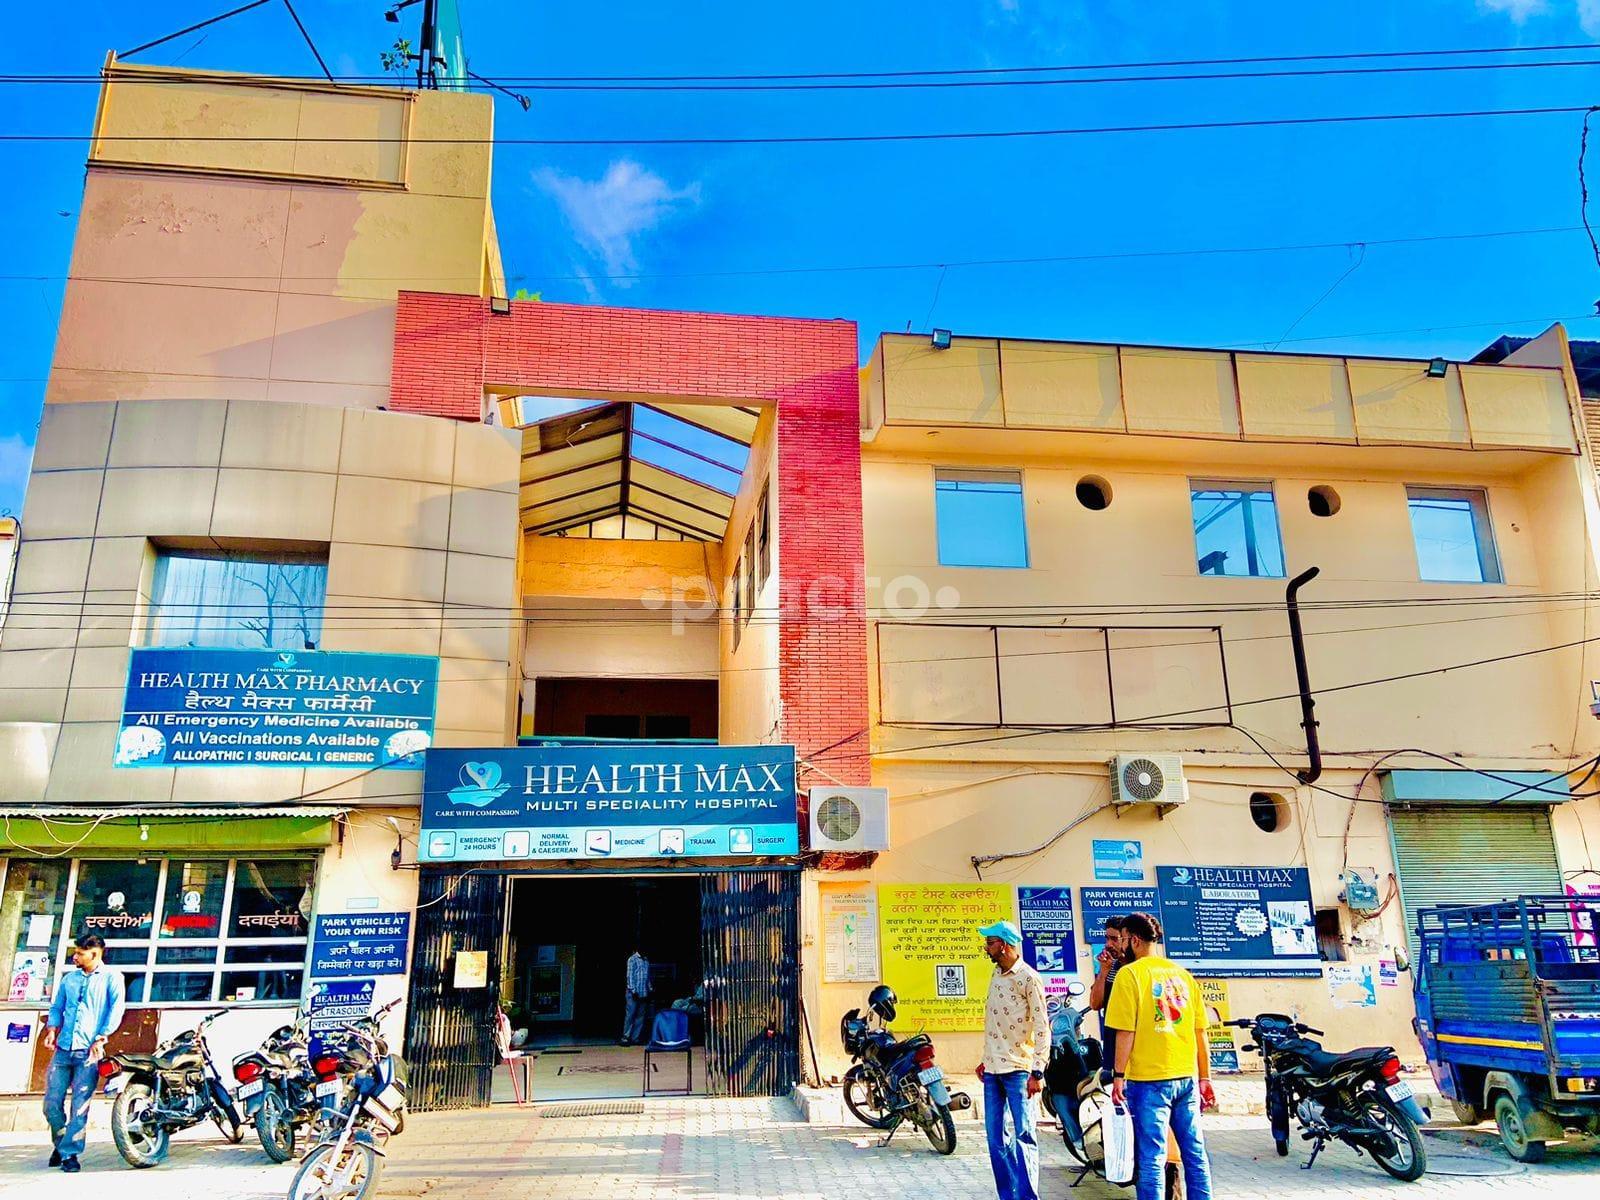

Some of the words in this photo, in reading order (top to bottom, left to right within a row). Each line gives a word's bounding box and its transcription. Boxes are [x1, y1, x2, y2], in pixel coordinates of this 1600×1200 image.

[140, 672, 229, 689] HEALTH
[234, 673, 290, 690] MAX
[294, 674, 424, 695] PHARMACY
[185, 690, 235, 709] हैल्थ
[241, 690, 297, 711] मैक्स
[136, 714, 159, 726] All
[164, 715, 259, 728] Emergency
[264, 715, 340, 728] Medicine
[343, 716, 419, 730] Available
[171, 731, 193, 744] All
[199, 731, 302, 746] Vaccinations
[306, 732, 380, 747] Available
[173, 751, 244, 761] ALLOPATHIC
[254, 751, 313, 762] SURGICAL
[323, 752, 375, 762] GENERIC
[522, 764, 684, 795] HEALTH
[694, 763, 784, 793] MAX
[526, 800, 578, 811] MULTI
[585, 799, 688, 811] SPECIALITY
[695, 798, 778, 809] HOSPITAL
[475, 809, 520, 817] COMPASSION
[614, 838, 646, 846] MEDICINE
[1194, 868, 1253, 882] HEALTH
[1257, 869, 1293, 882] MAX
[1203, 890, 1258, 899] LABORATORY
[1023, 911, 1070, 919] ULTRASOUND
[321, 918, 347, 926] PARK
[350, 917, 391, 926] VEHICLE
[393, 917, 406, 925] AT
[324, 928, 351, 936] YOUR
[353, 927, 376, 935] OWN
[378, 927, 401, 935] RISK
[1203, 982, 1221, 991] FALL
[315, 994, 350, 1003] HEALTH
[351, 993, 372, 1001] MAX
[1202, 993, 1226, 1001] MENT
